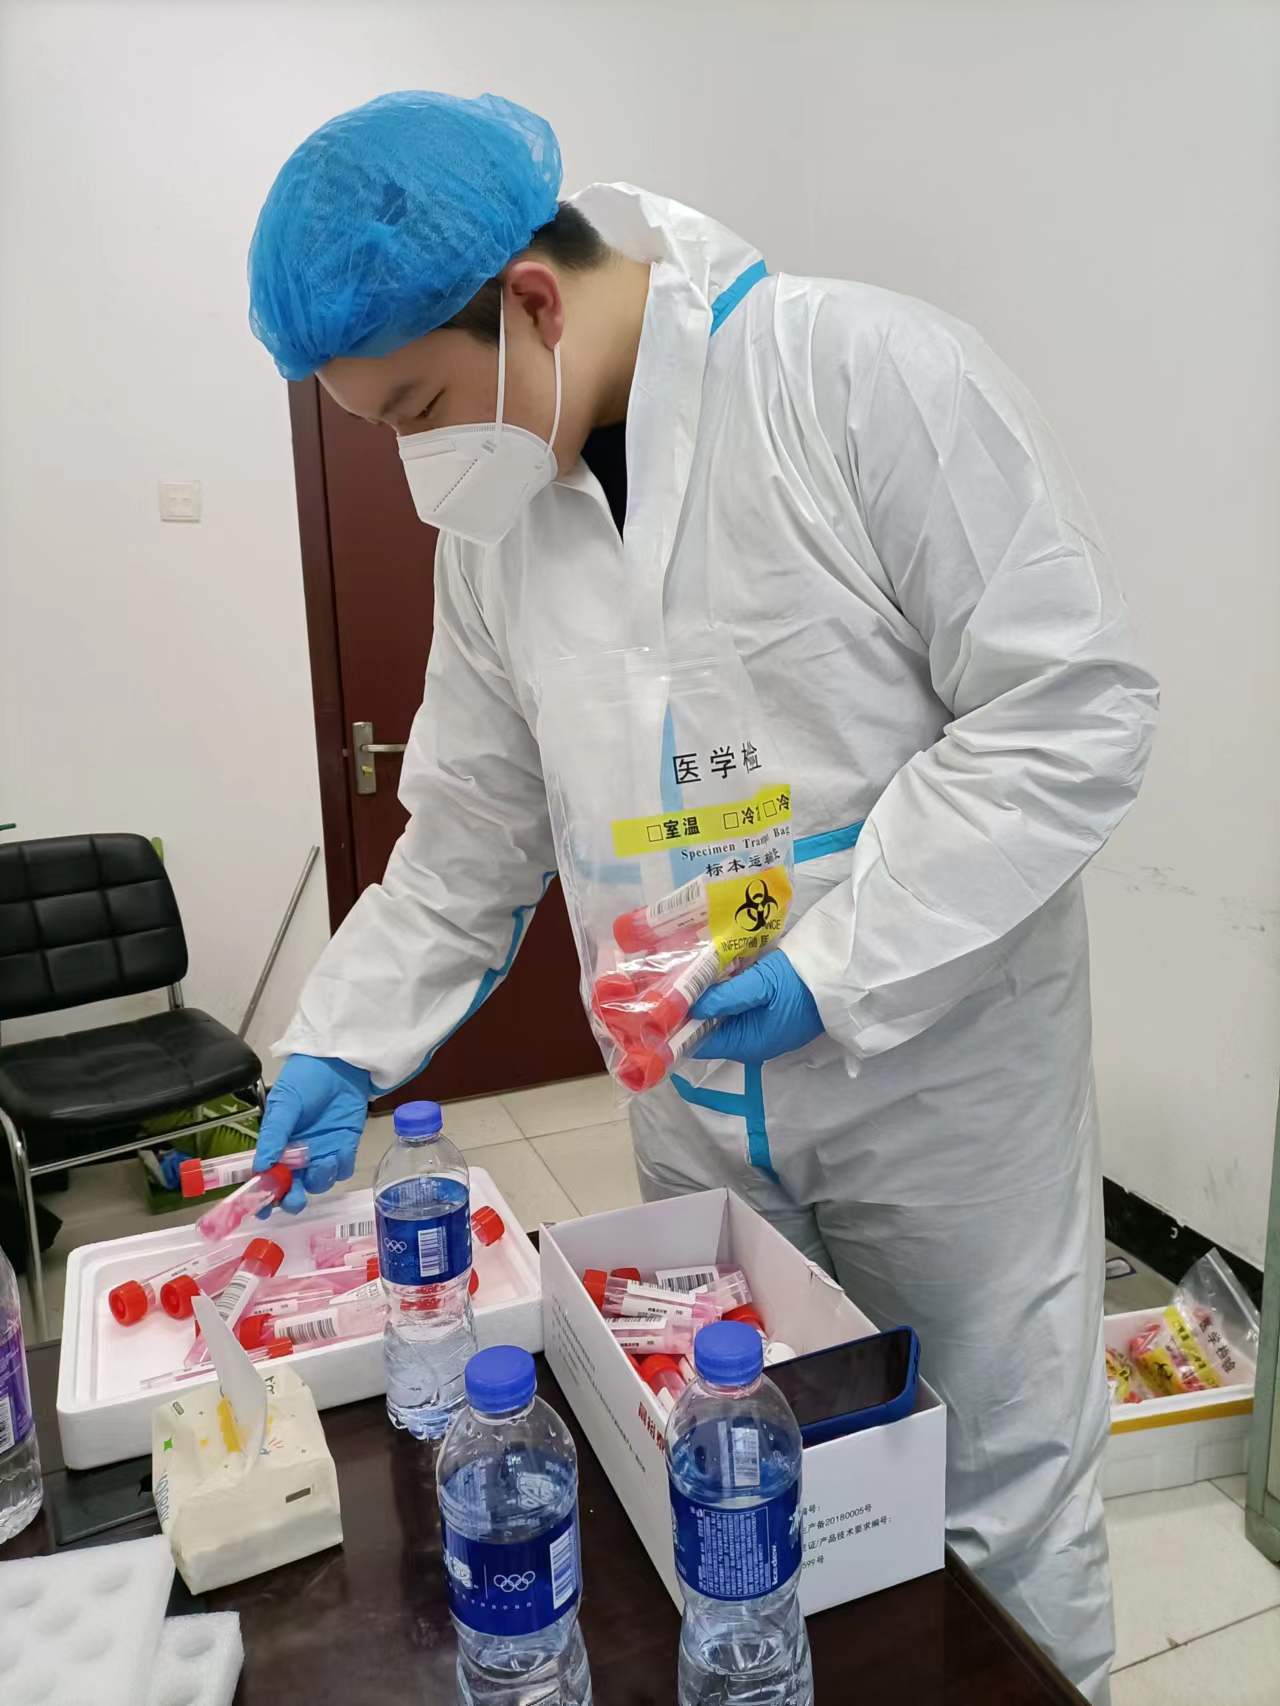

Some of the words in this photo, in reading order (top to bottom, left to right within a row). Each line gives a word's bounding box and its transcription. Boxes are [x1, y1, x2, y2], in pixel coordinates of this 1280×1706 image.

[663, 816, 701, 839] 室温
[741, 806, 761, 825] 冷
[680, 842, 737, 861] Specimen
